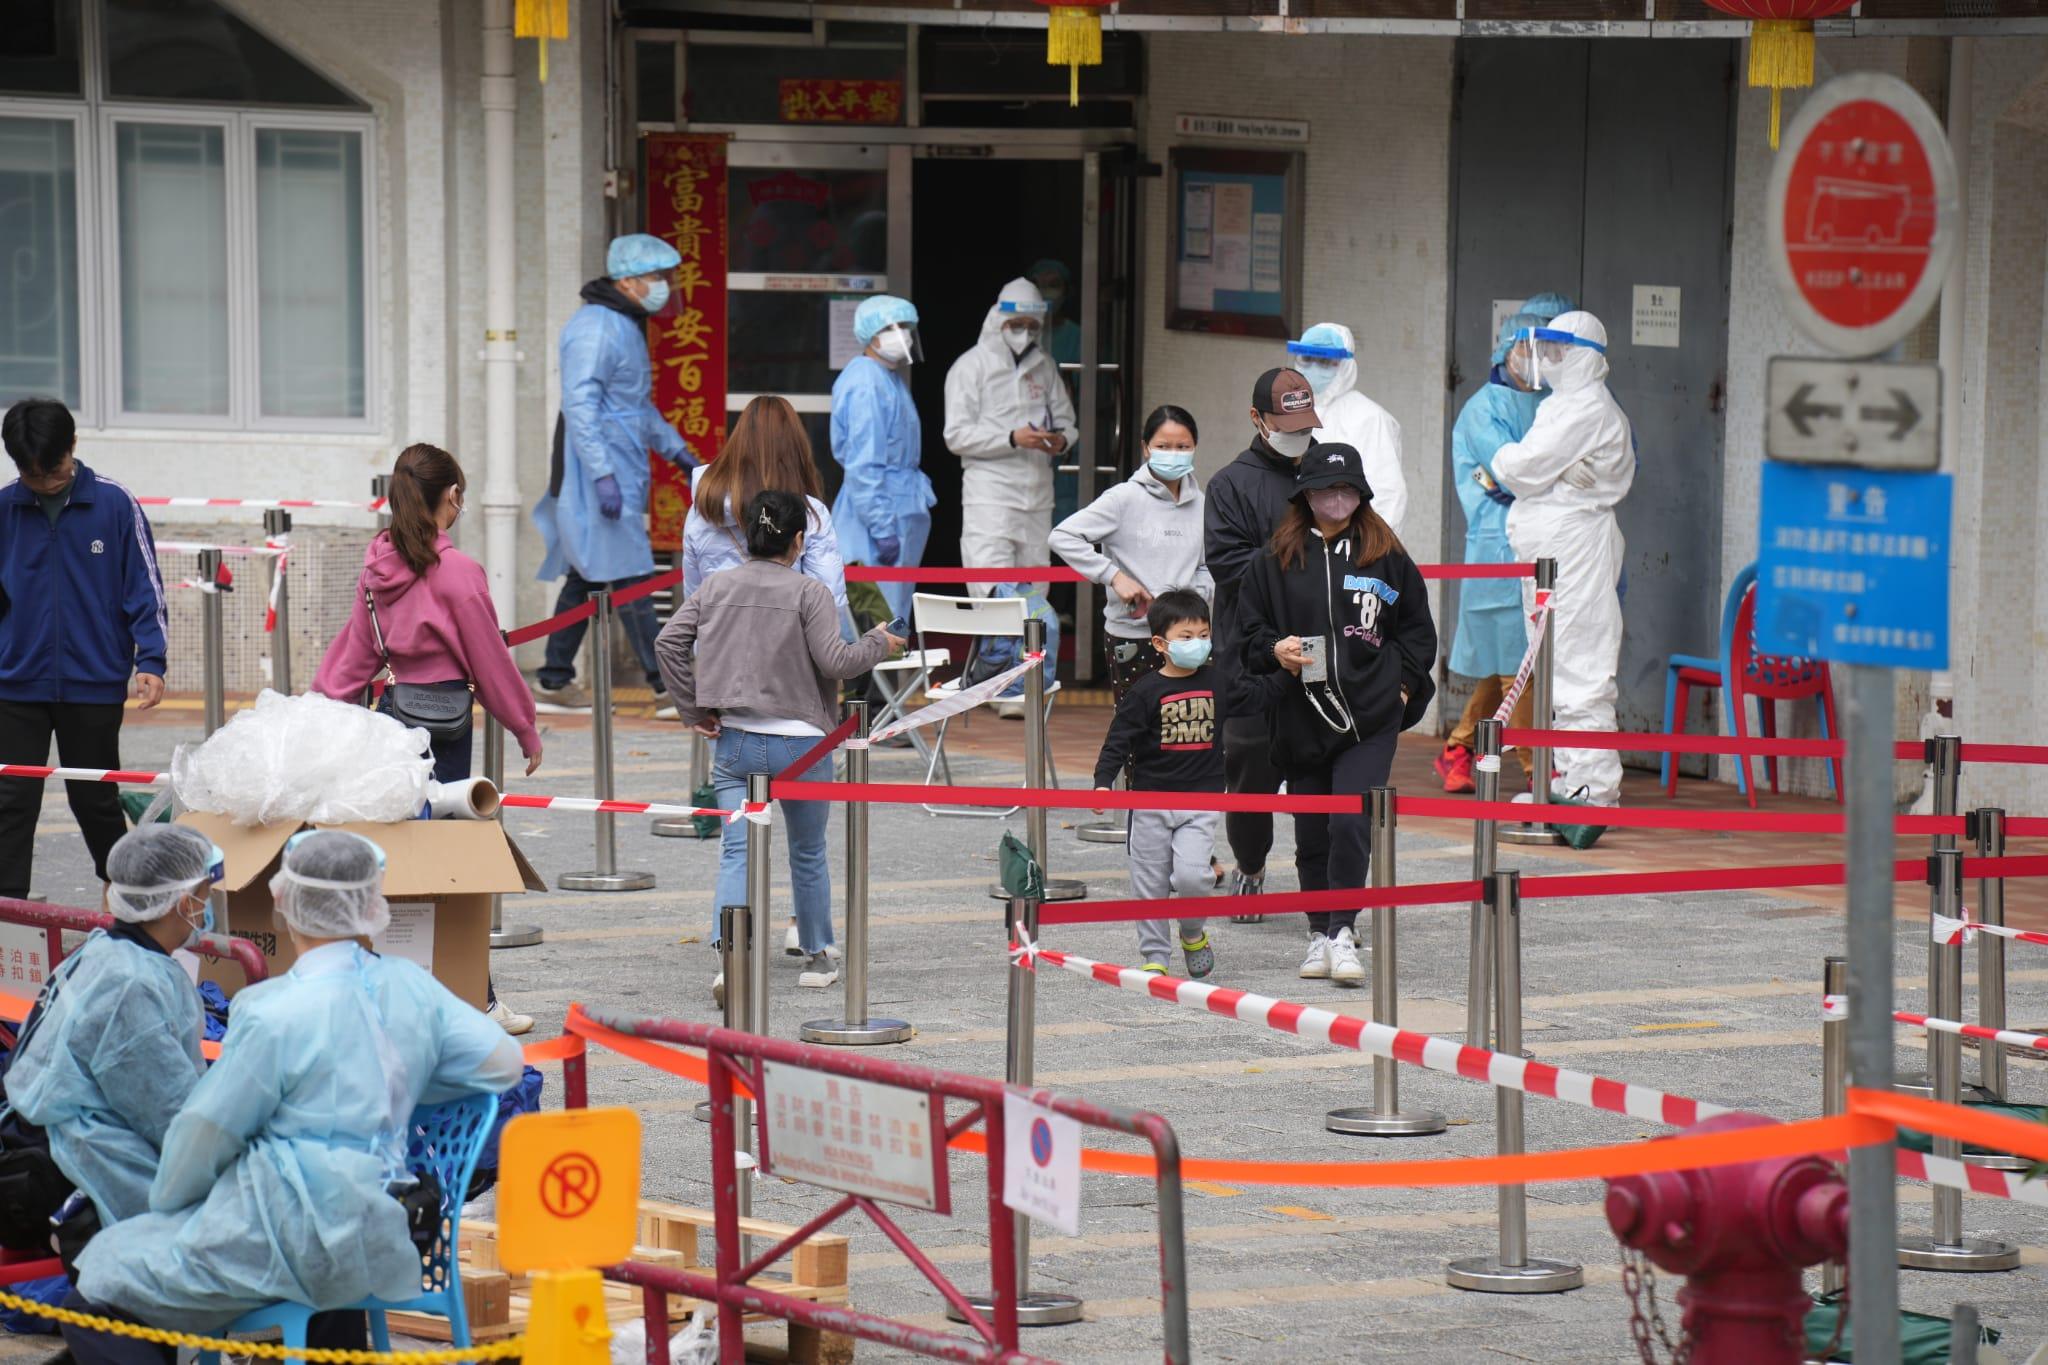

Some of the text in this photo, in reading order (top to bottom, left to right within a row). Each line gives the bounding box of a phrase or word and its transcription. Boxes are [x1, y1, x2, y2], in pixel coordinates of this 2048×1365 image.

[784, 88, 899, 113] 出入平安
[661, 164, 714, 487] 富貴平安百福
[1161, 698, 1215, 723] RUN
[1161, 720, 1215, 743] DMC
